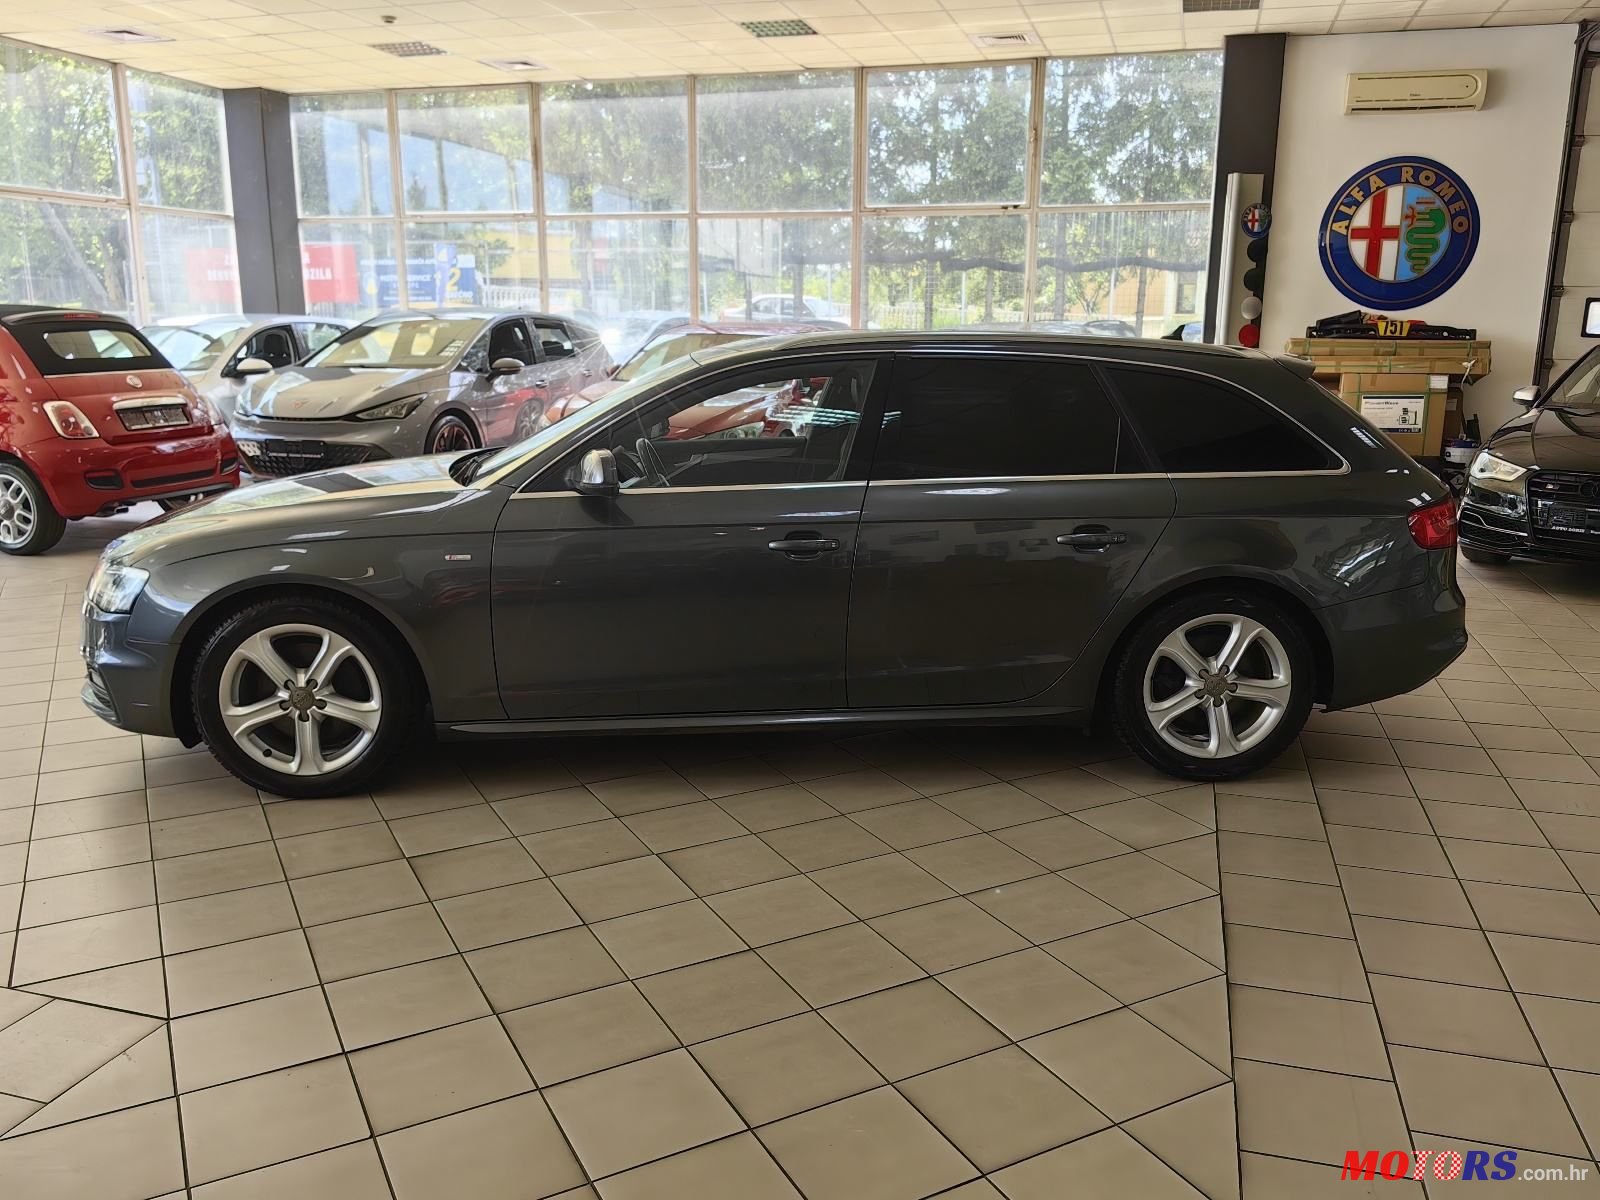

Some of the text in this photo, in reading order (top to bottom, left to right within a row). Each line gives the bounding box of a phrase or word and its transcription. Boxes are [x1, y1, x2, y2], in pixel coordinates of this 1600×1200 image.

[1331, 166, 1469, 236] ALFA ROMEO
[1383, 320, 1404, 336] 751
